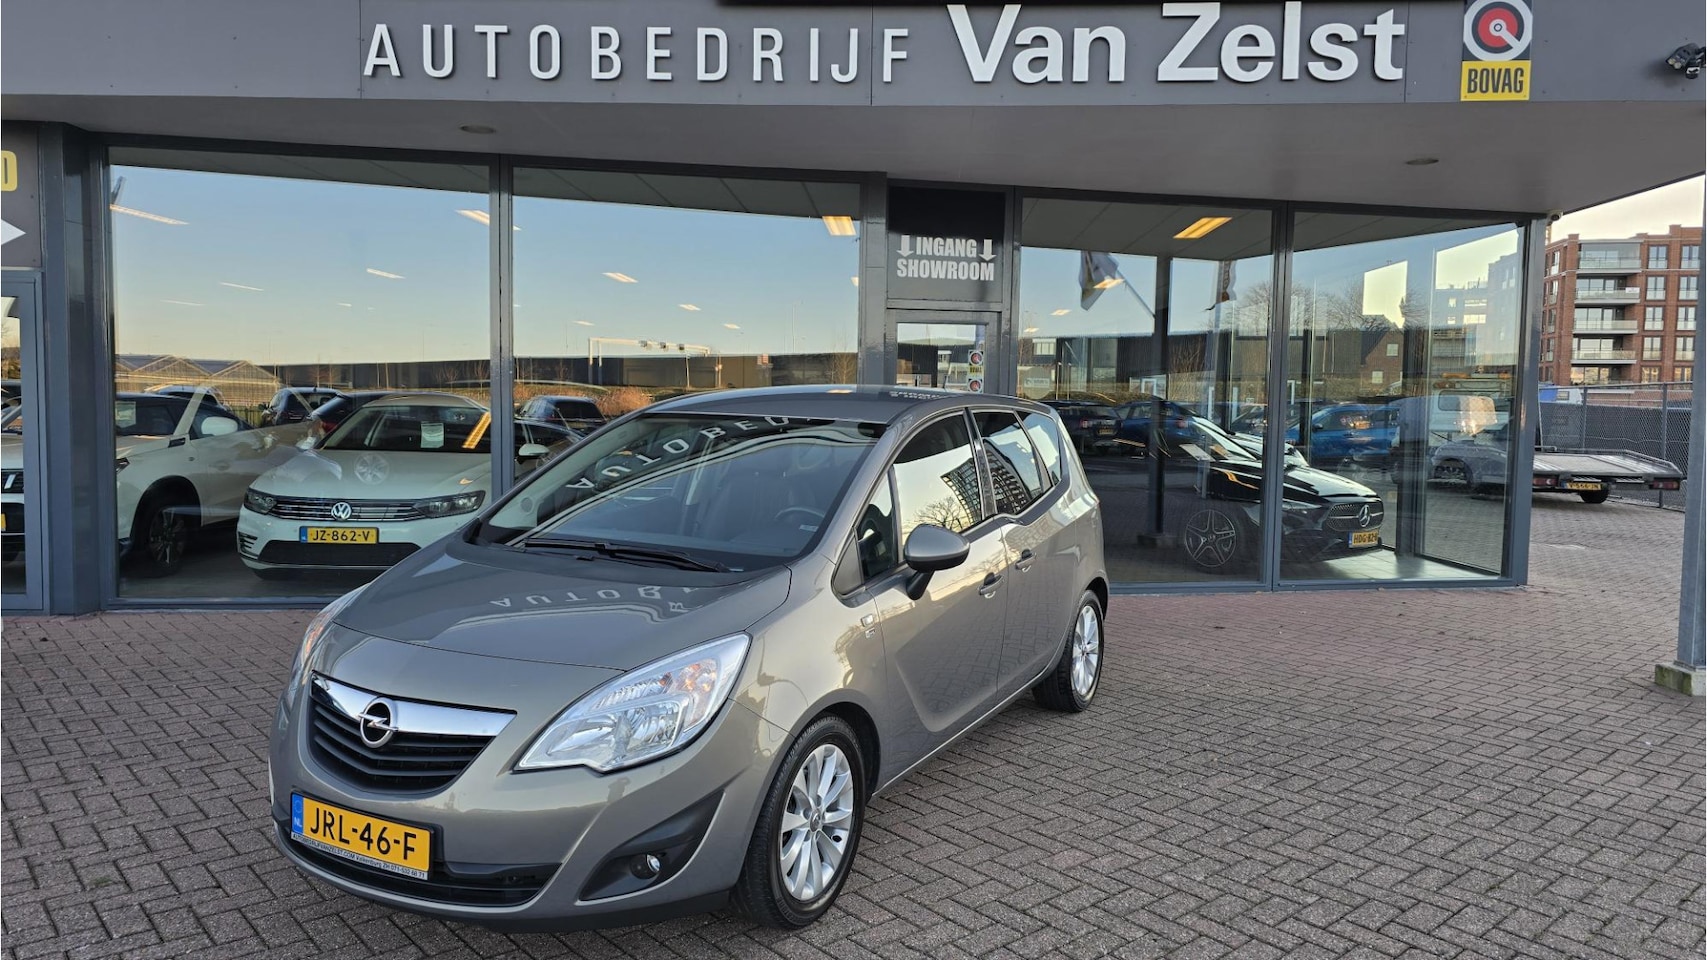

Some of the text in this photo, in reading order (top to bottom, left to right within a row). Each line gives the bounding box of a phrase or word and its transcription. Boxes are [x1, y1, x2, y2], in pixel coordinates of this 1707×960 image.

[363, 1, 1405, 84] AUTOBEDRIJF Van Zelst
[1467, 67, 1525, 94] BOVAG
[916, 236, 977, 258] INGANG
[896, 258, 995, 281] SHOWROOM
[312, 530, 370, 542] JZ-862-V
[310, 807, 417, 860] JRL-46-F
